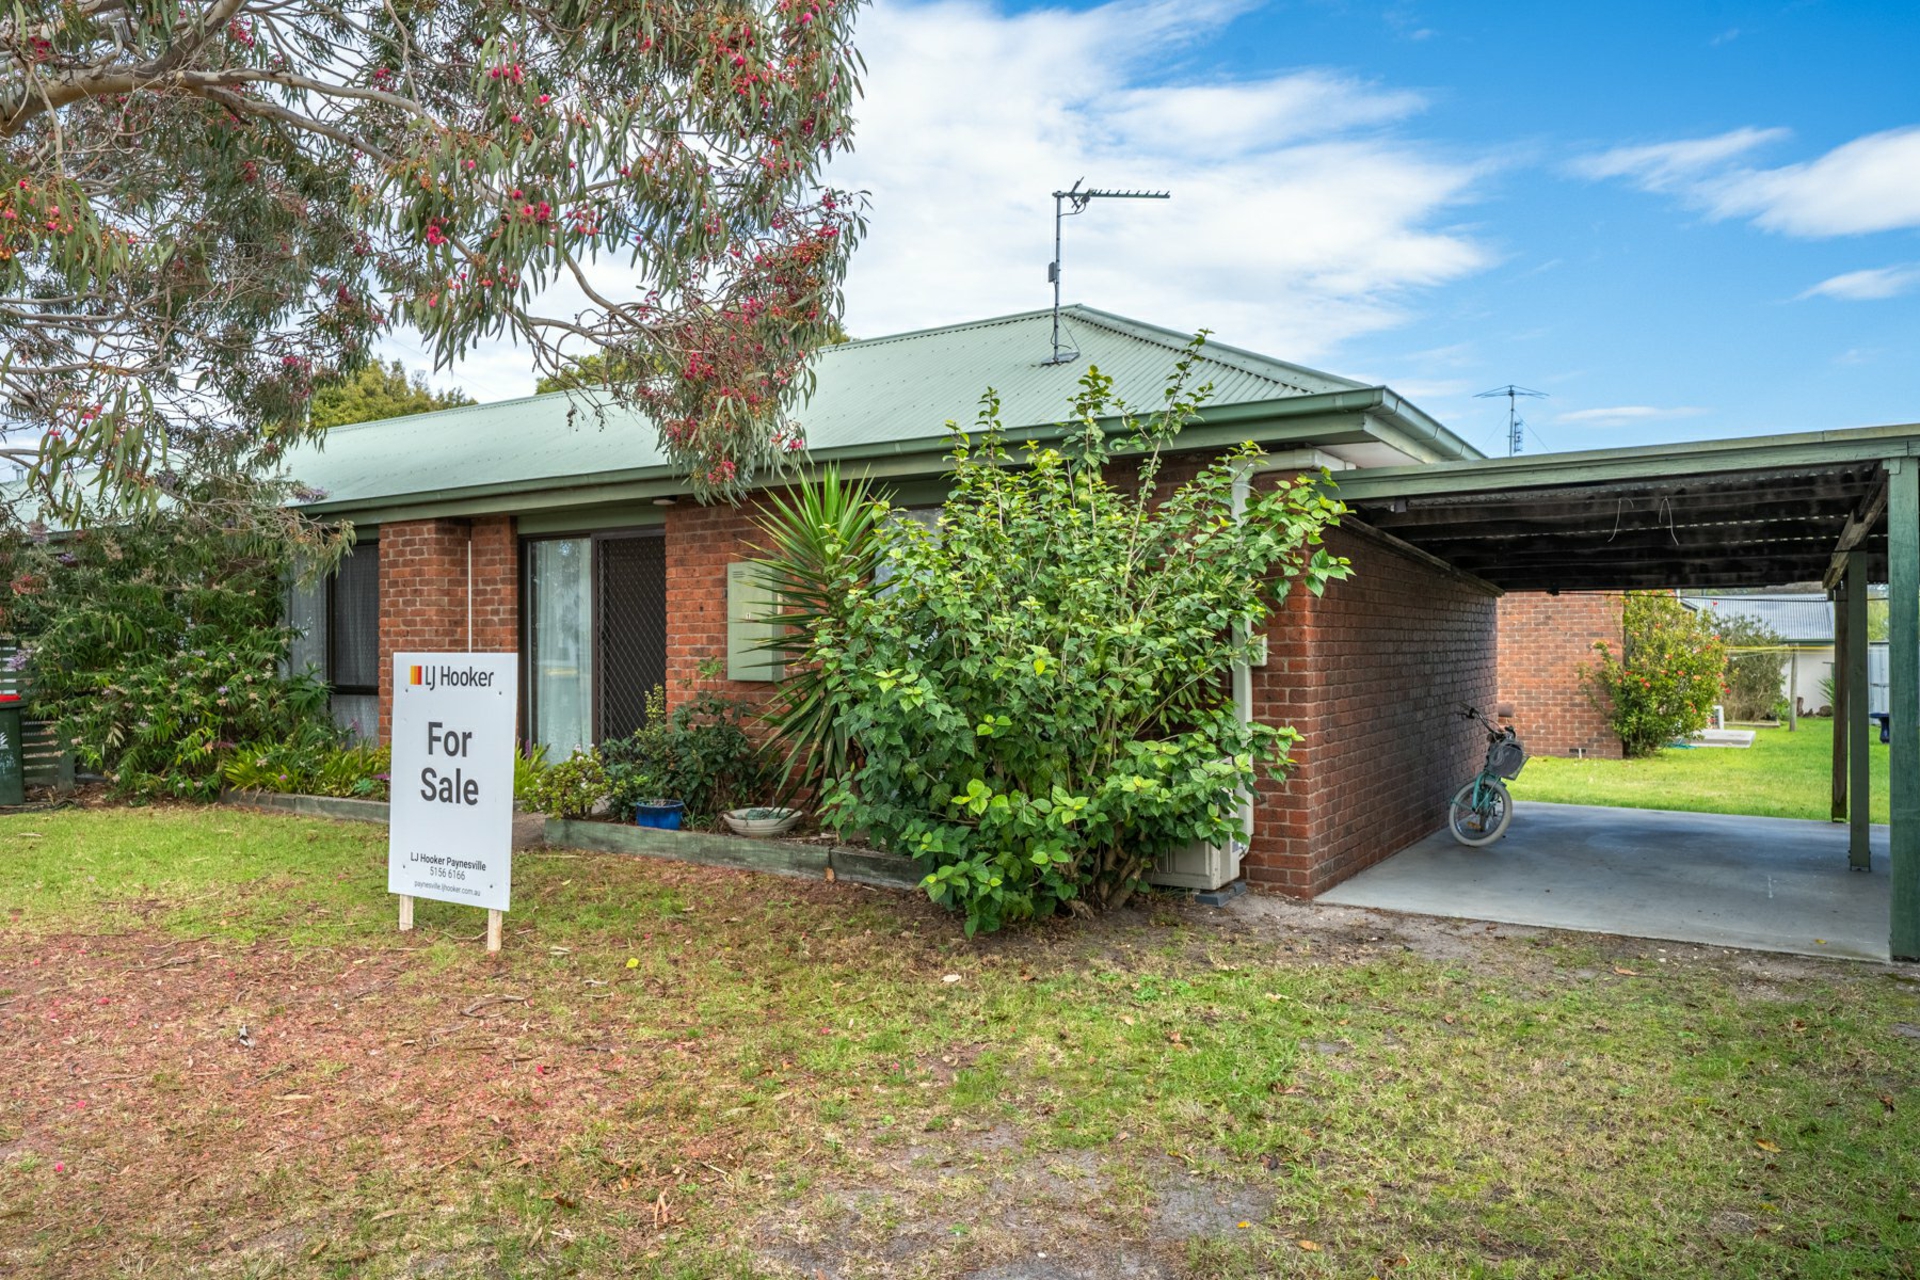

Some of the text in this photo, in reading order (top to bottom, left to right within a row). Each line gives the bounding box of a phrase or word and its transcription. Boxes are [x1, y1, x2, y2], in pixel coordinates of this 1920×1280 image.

[425, 665, 495, 691] LJ Hooker
[428, 721, 472, 757] For
[420, 767, 479, 806] Sale
[410, 852, 487, 871] LJ Hooker Paynesville
[430, 866, 466, 880] 5156 6166
